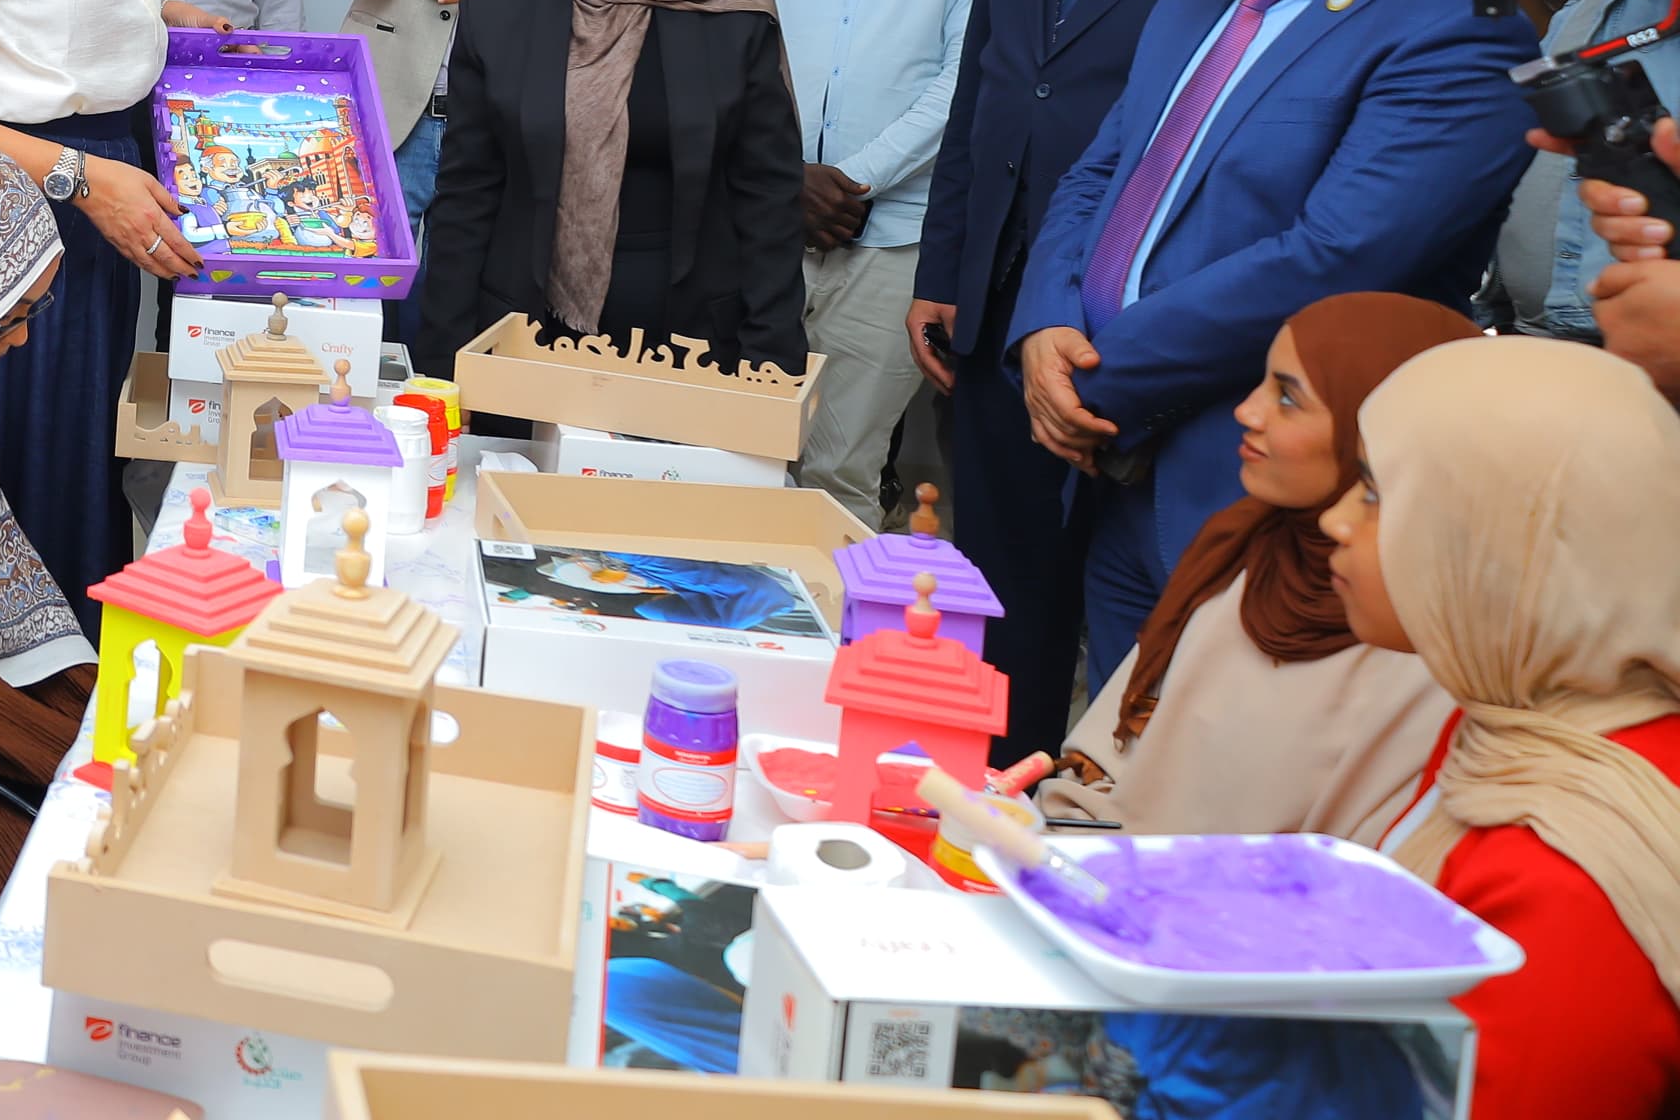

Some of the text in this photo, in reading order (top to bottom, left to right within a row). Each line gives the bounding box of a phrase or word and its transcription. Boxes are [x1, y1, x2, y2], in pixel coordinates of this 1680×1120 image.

[321, 343, 354, 357] Crafty
[209, 400, 221, 410] fin
[119, 1023, 181, 1048] finance
